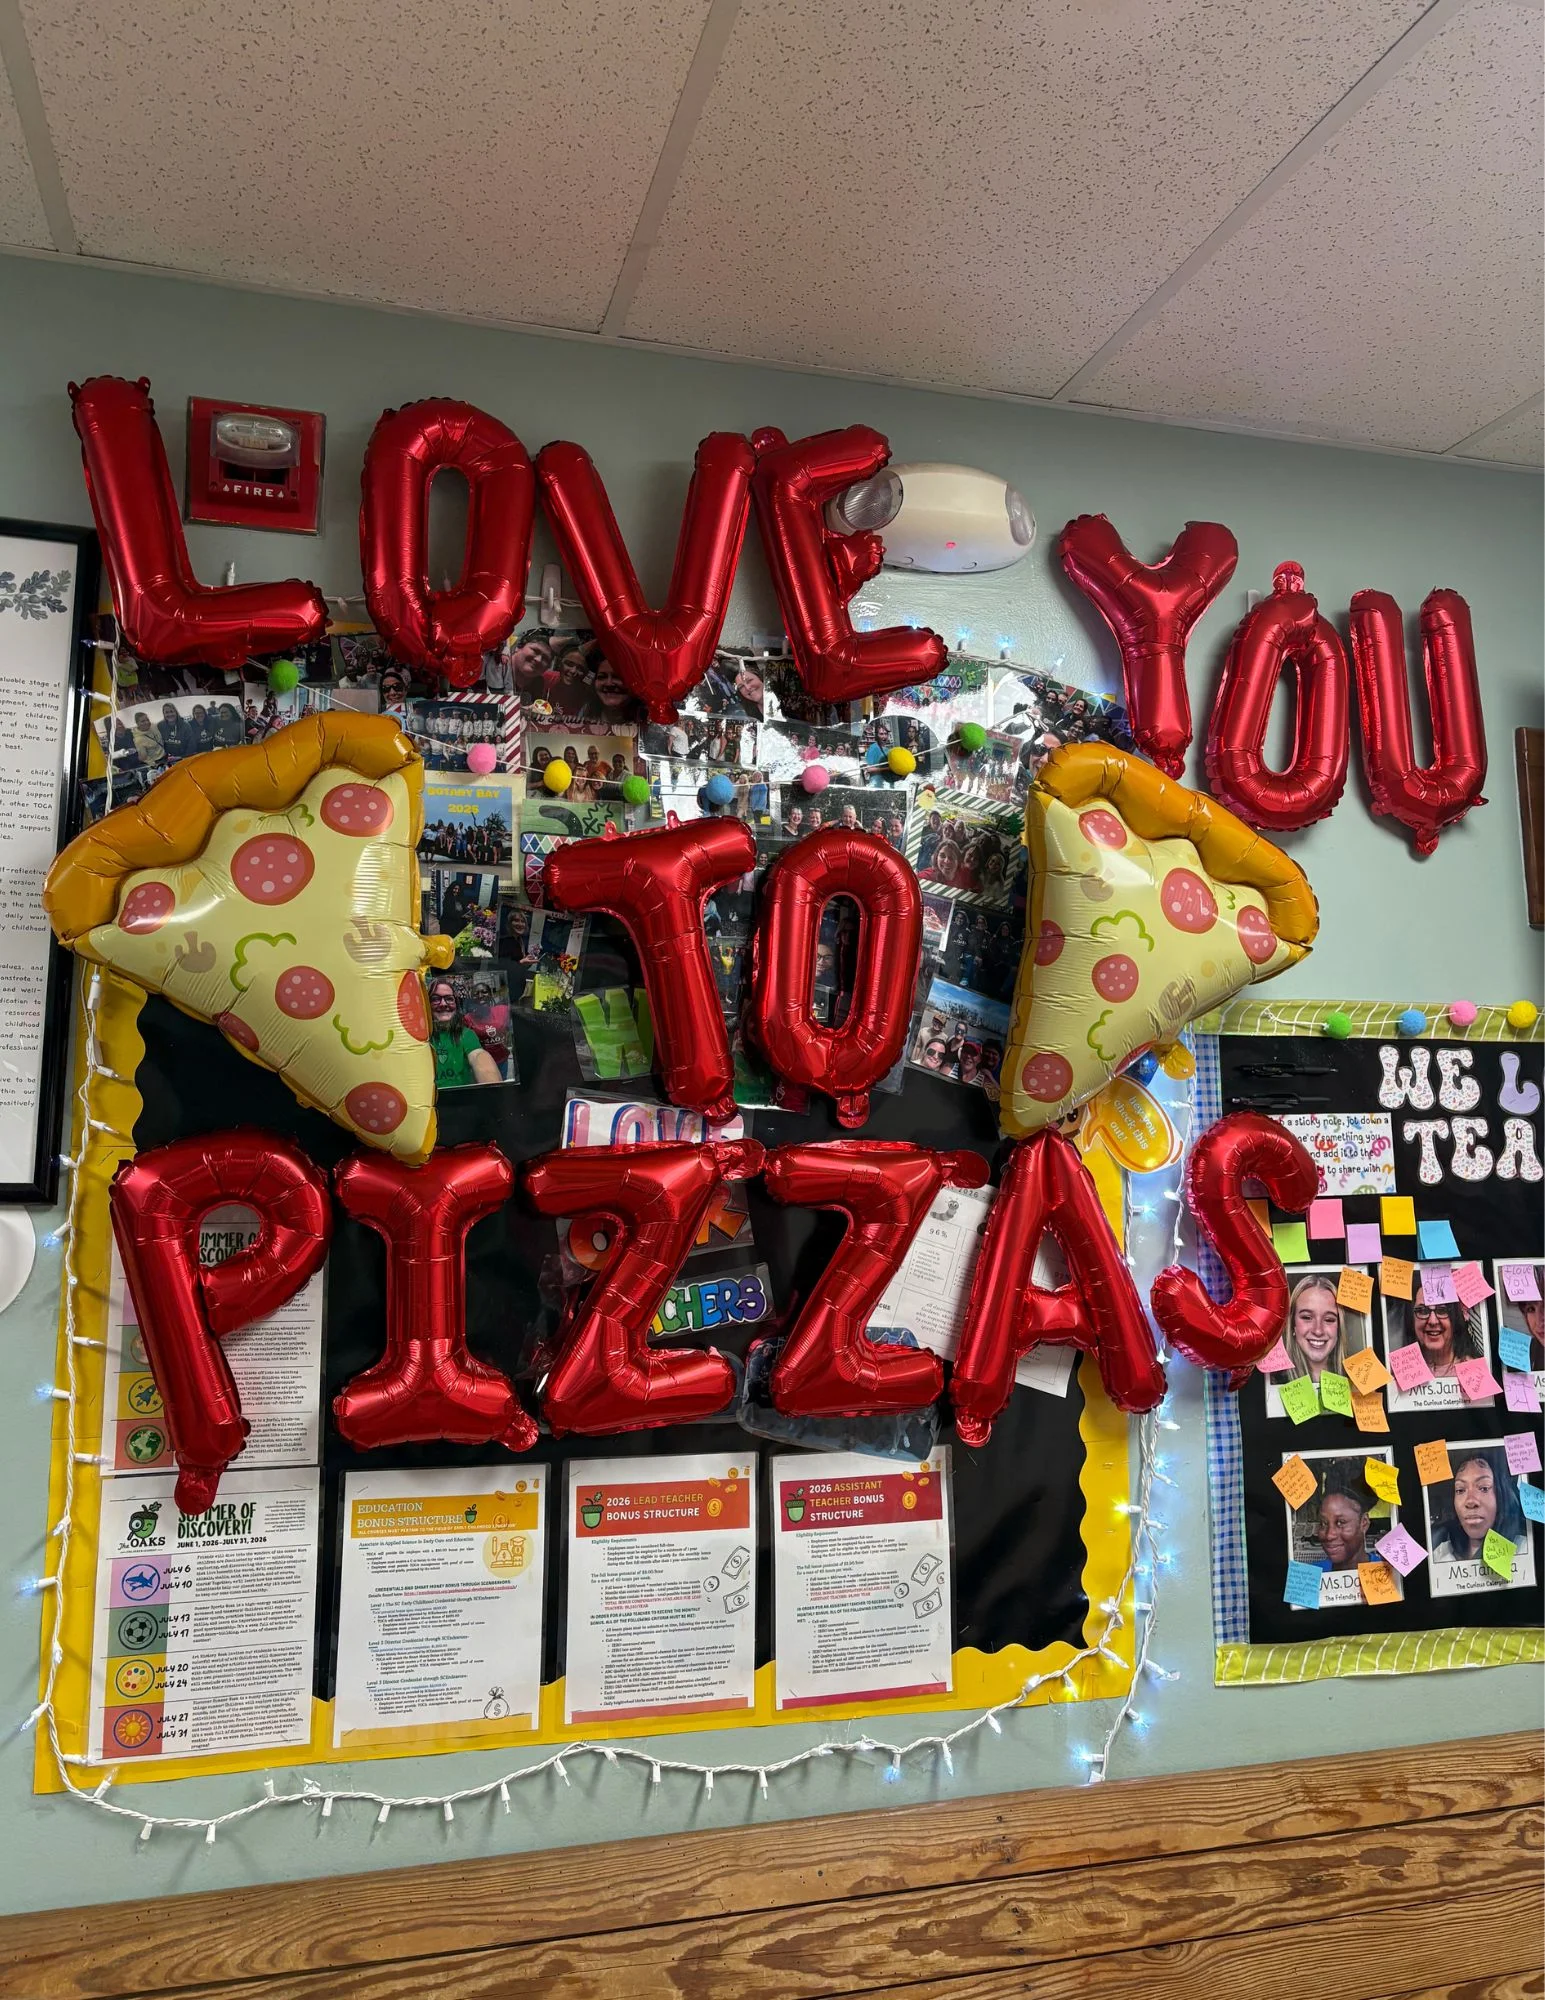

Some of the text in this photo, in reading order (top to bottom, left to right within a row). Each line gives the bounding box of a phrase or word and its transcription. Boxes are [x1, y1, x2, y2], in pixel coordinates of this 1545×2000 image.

[233, 485, 274, 498] FIRE
[68, 376, 1489, 854] LOVE YOU
[33, 702, 59, 711] setting
[33, 802, 52, 810] TOCA
[20, 824, 51, 832] supports
[5, 912, 23, 921] daily
[11, 924, 47, 932] childhood
[543, 814, 923, 1130] TO
[5, 1009, 40, 1017] resources
[1378, 1044, 1481, 1110] WE
[1294, 1117, 1321, 1128] sticky
[1360, 1115, 1382, 1125] down
[1132, 1128, 1149, 1150] this
[1321, 1131, 1364, 1144] something
[1365, 1133, 1381, 1142] you
[1323, 1150, 1339, 1158] add
[1402, 1117, 1545, 1185] TEA
[1338, 1165, 1361, 1174] share
[111, 1111, 1318, 1514] PIZZAS
[1424, 1399, 1443, 1407] Curious
[809, 1480, 883, 1494] 2026 ASSISTANT
[606, 1493, 704, 1507] 2026 LEAD TEACHER
[810, 1494, 885, 1508] TEACHER BONUS
[240, 1502, 258, 1519] OF
[358, 1502, 423, 1514] EDUCATION
[606, 1507, 700, 1521] BONUS STRUCTURE
[357, 1514, 463, 1529] BONUS STRUCTURE
[810, 1509, 864, 1522] STRUCTURE
[178, 1518, 253, 1539] DISCOVERY!
[130, 1536, 166, 1548] OAKS
[177, 1541, 194, 1549] JUNE
[239, 1537, 250, 1546] 31,
[250, 1535, 267, 1543] 2026
[163, 1565, 191, 1575] JULY 6
[160, 1582, 180, 1590] JULY
[159, 1613, 190, 1624] JULY 13
[180, 1629, 189, 1637] 17
[155, 1663, 189, 1673] JULY 20
[155, 1679, 187, 1689] JULY 24
[157, 1713, 189, 1723] JULY 27
[156, 1729, 188, 1739] JULY 31
